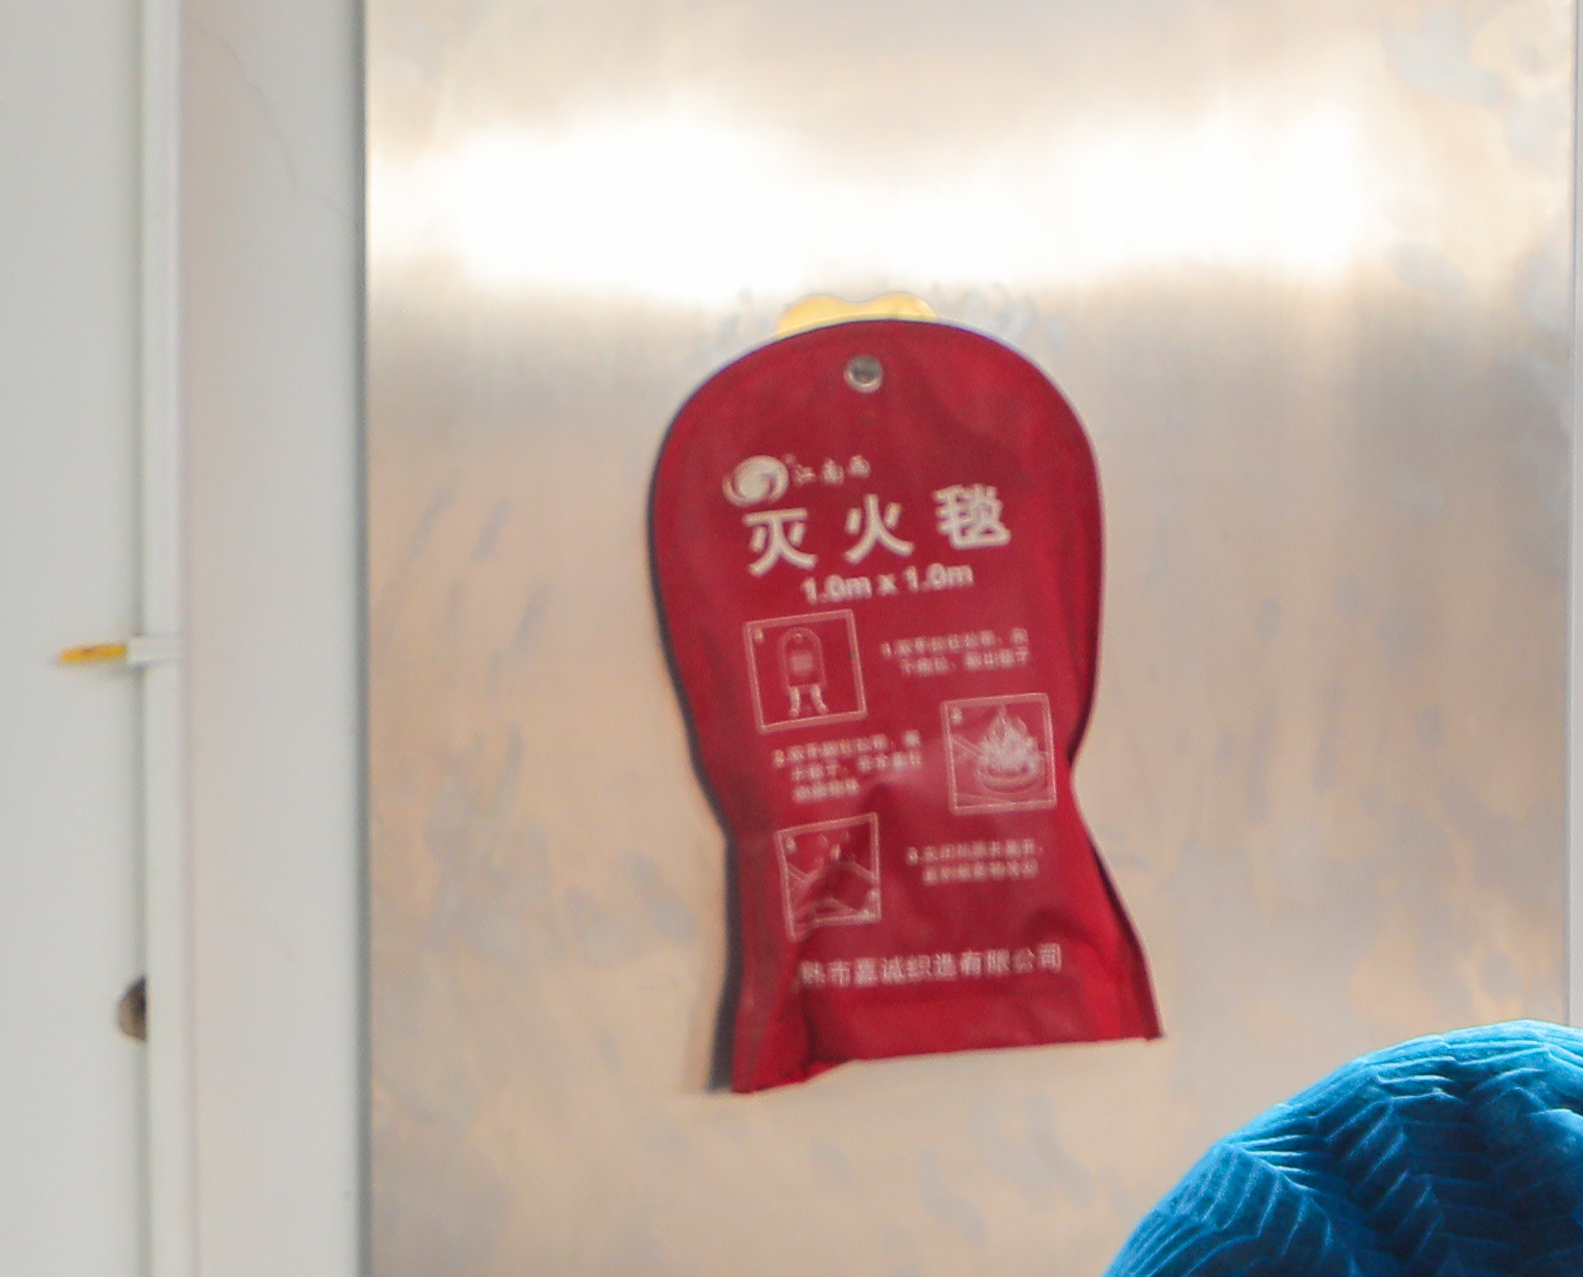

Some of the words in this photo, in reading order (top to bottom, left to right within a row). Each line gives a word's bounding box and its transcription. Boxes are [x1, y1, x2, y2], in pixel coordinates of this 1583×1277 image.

[741, 483, 1013, 577] 灭火毯
[800, 573, 873, 605] 1.0m
[903, 561, 975, 593] 1.0m
